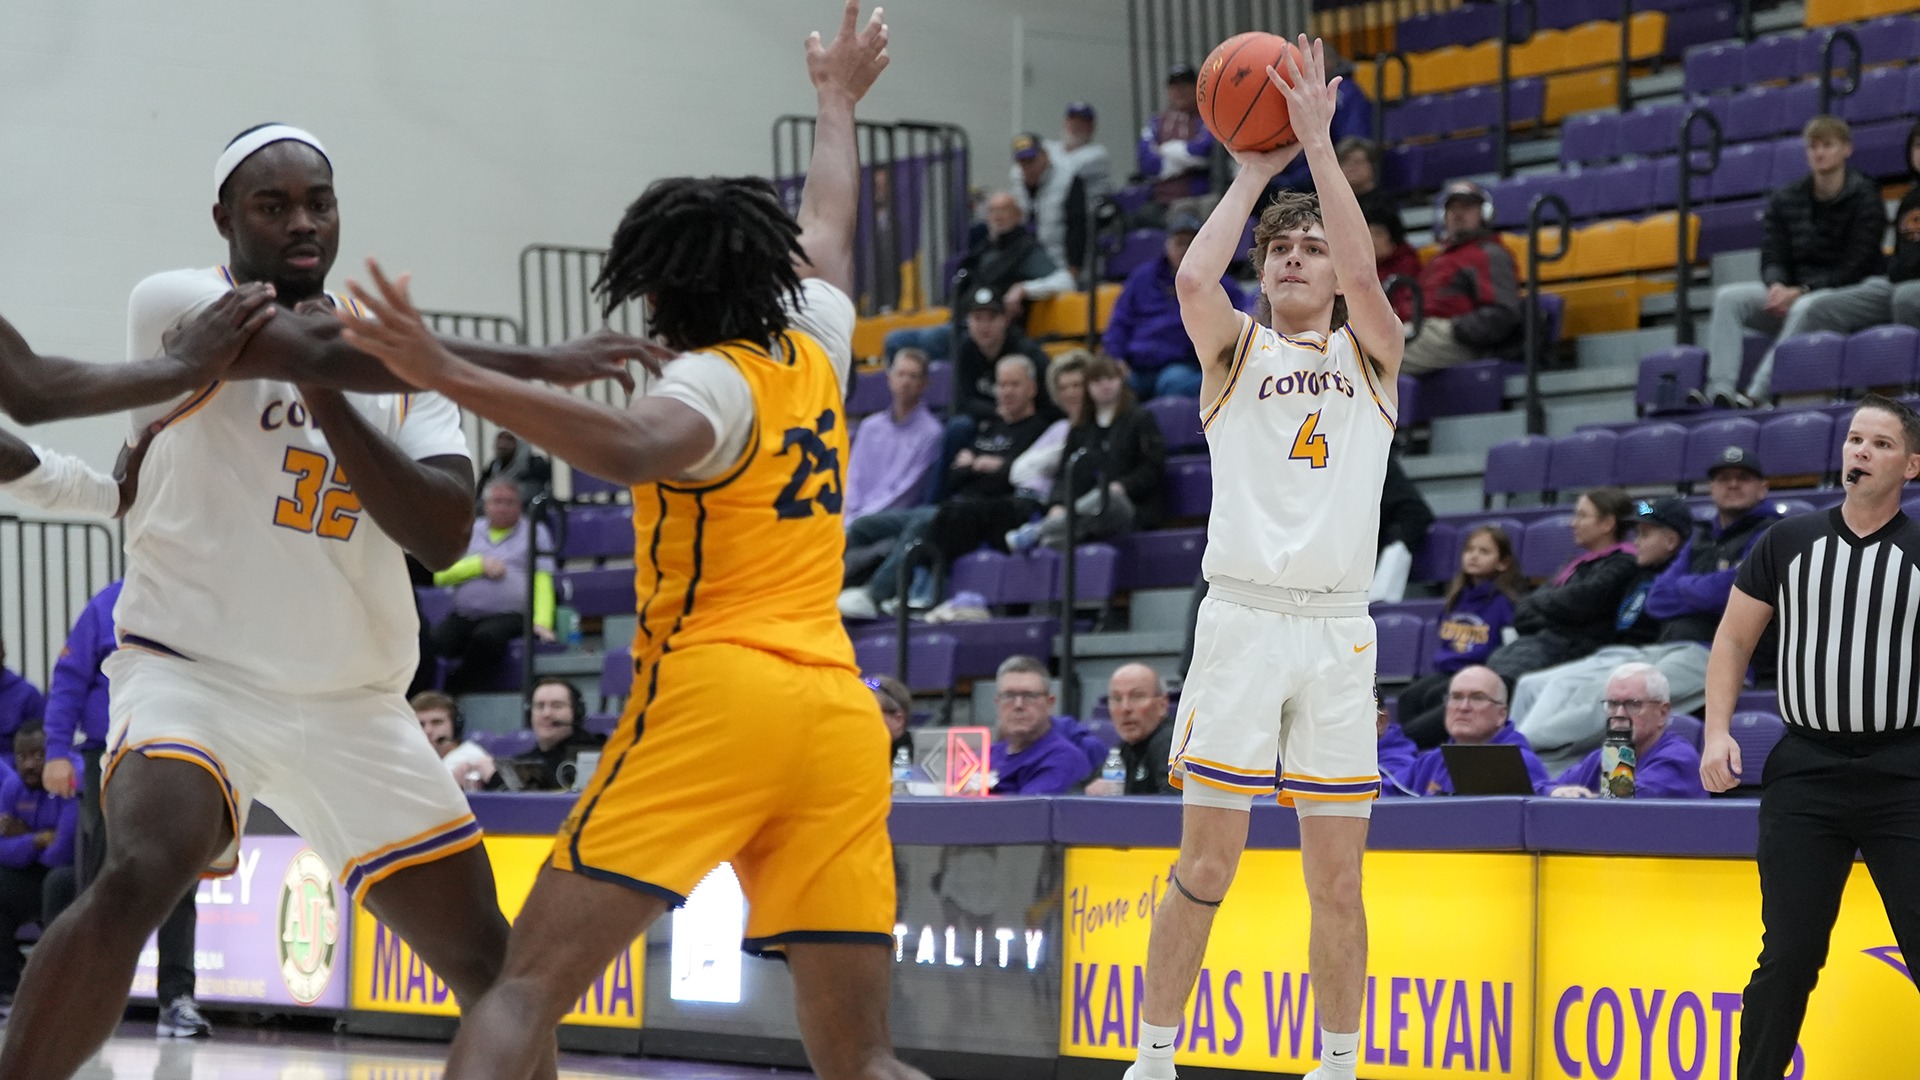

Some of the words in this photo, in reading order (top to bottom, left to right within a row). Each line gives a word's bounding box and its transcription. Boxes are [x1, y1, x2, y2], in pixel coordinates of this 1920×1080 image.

[260, 400, 320, 431] CO
[1259, 370, 1354, 400] COYOTES
[773, 409, 843, 520] 25
[1288, 408, 1329, 469] 4
[273, 445, 361, 542] 32
[1069, 885, 1130, 953] Home
[1072, 963, 1244, 1056] KAAS
[1263, 971, 1513, 1074] WLEYAN
[1553, 985, 1806, 1080] COYOT
